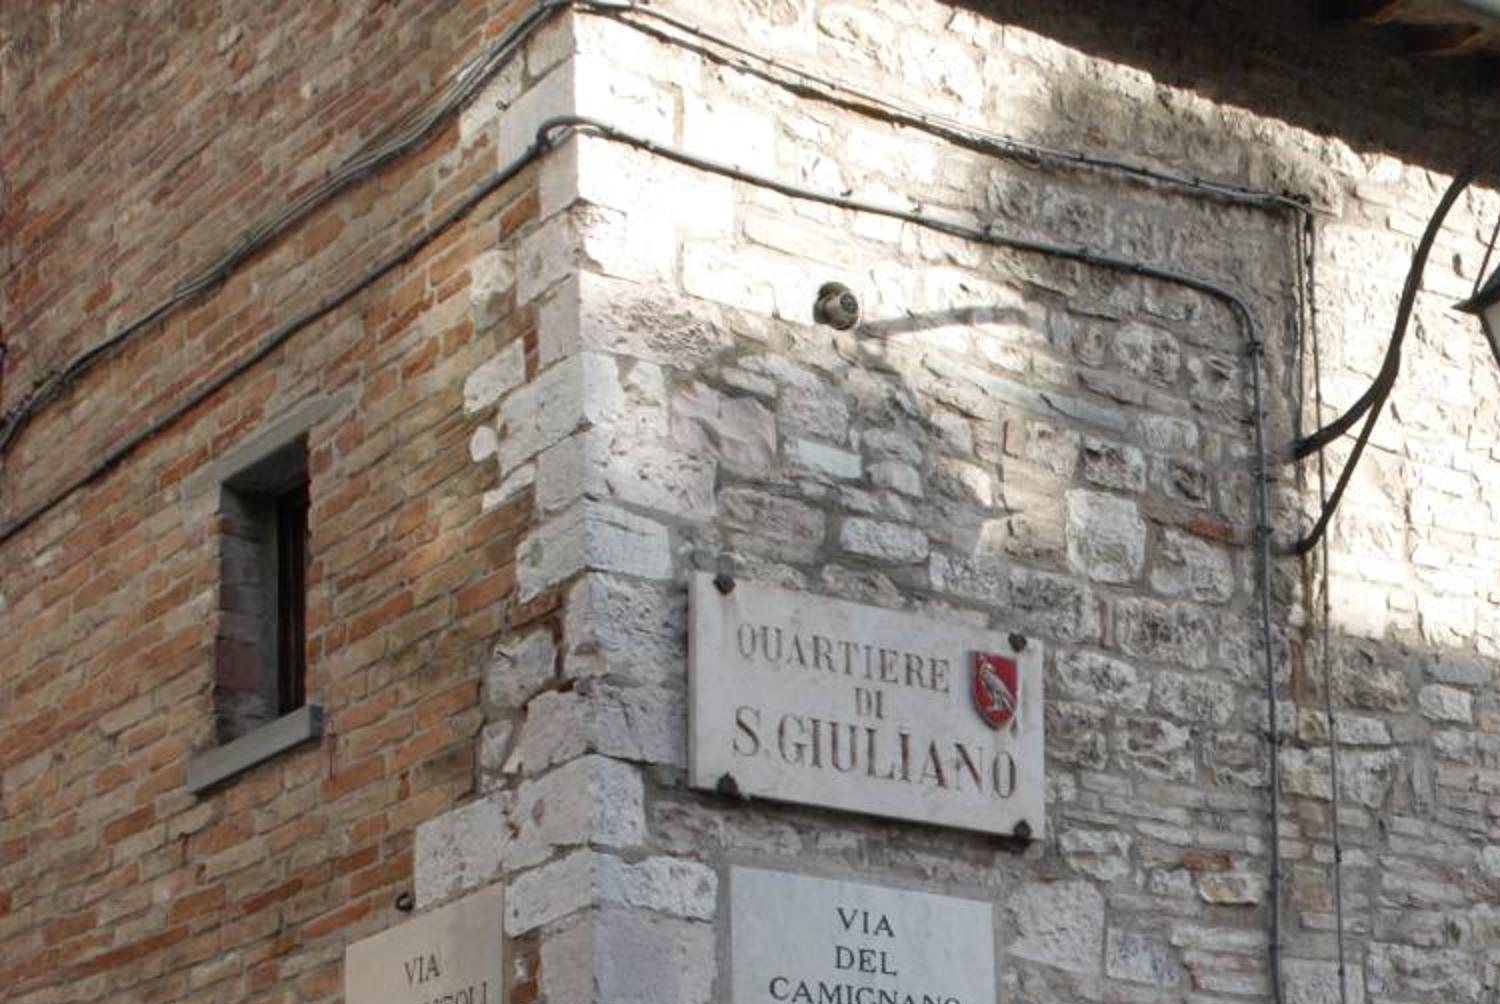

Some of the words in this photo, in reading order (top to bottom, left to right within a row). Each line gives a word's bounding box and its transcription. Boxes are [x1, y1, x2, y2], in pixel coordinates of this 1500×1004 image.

[736, 622, 951, 694] QUARTIERE
[854, 686, 885, 720] DI
[836, 906, 896, 938] VIA
[403, 953, 441, 987] VIA
[834, 945, 898, 977] DEL
